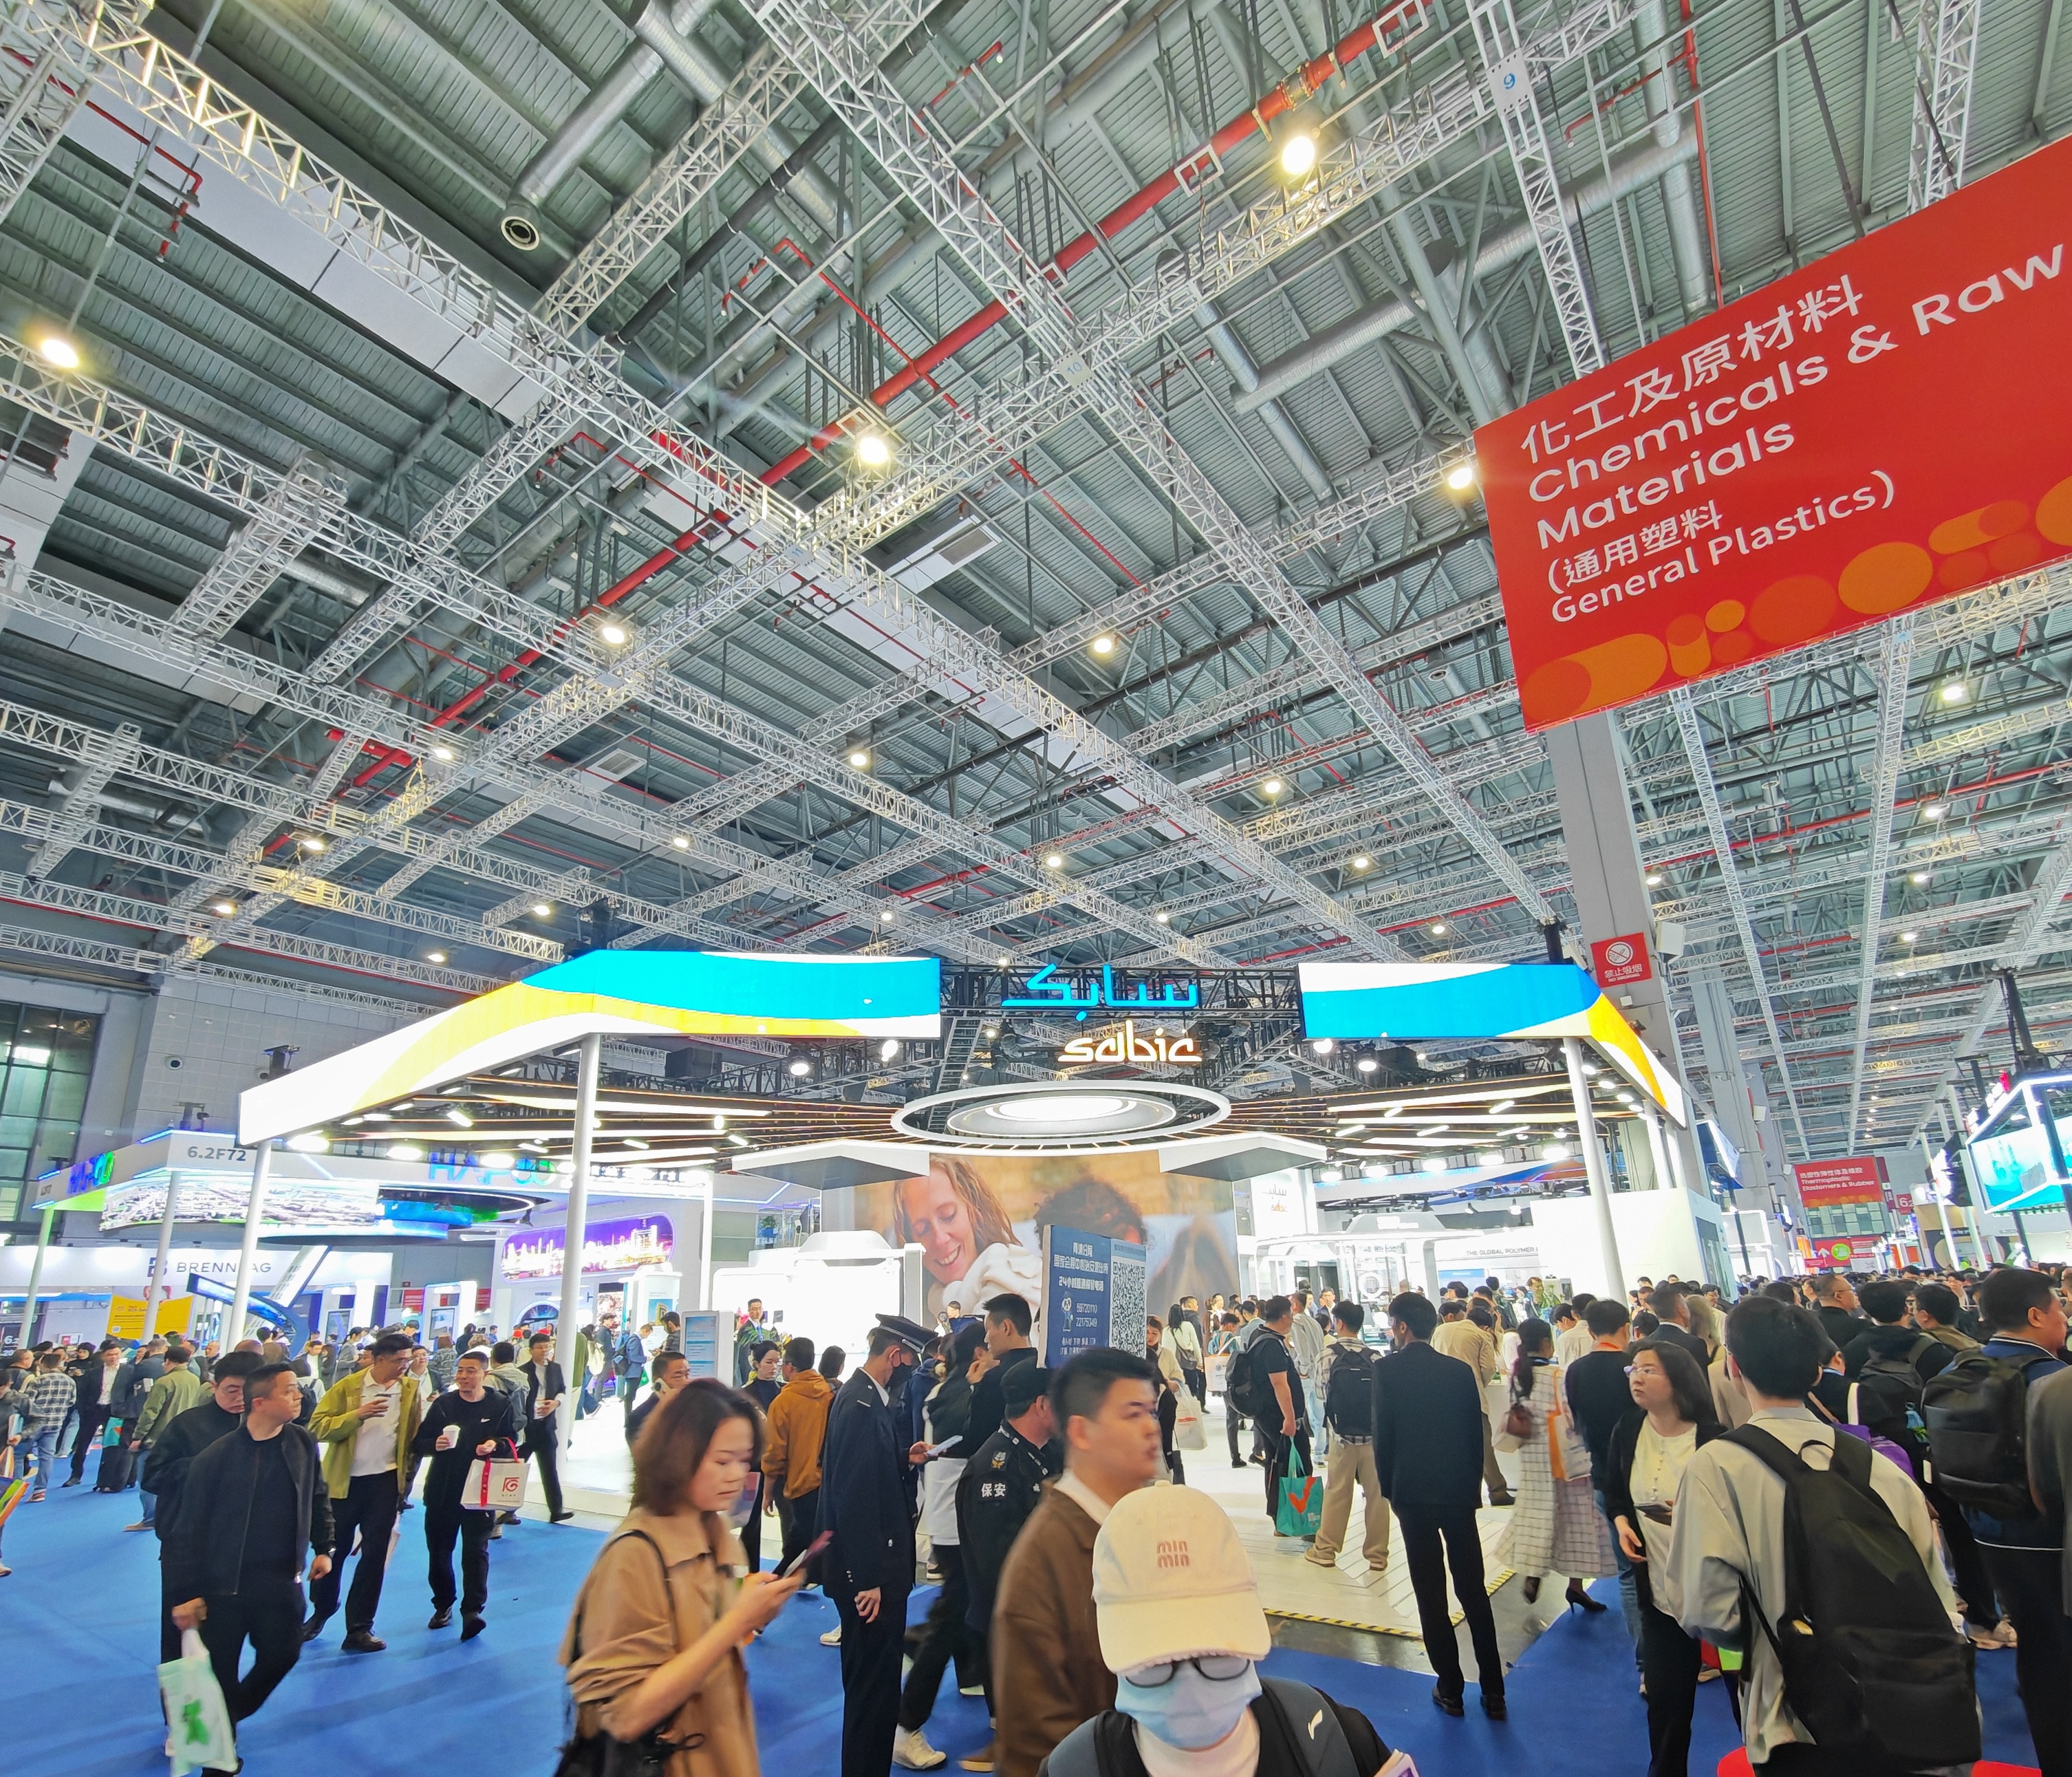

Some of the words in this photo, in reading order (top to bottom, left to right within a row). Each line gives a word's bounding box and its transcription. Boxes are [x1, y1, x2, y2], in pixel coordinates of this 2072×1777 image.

[1503, 73, 1515, 89] 9
[1067, 362, 1083, 375] 10
[1520, 274, 1864, 464] 化工及原材料
[1529, 354, 1828, 503] Chemicals
[1847, 323, 1899, 364] &
[1912, 244, 2064, 336] Raw
[1537, 422, 1795, 549] Materials
[1547, 499, 1723, 594] (通用塑料
[1551, 547, 1699, 622] General
[1709, 469, 1895, 565] Plastics)
[1057, 1020, 1202, 1062] sabic
[187, 1145, 246, 1161] 6.2F72
[176, 1262, 272, 1273] BRENNAG
[981, 1483, 1006, 1498] 保安
